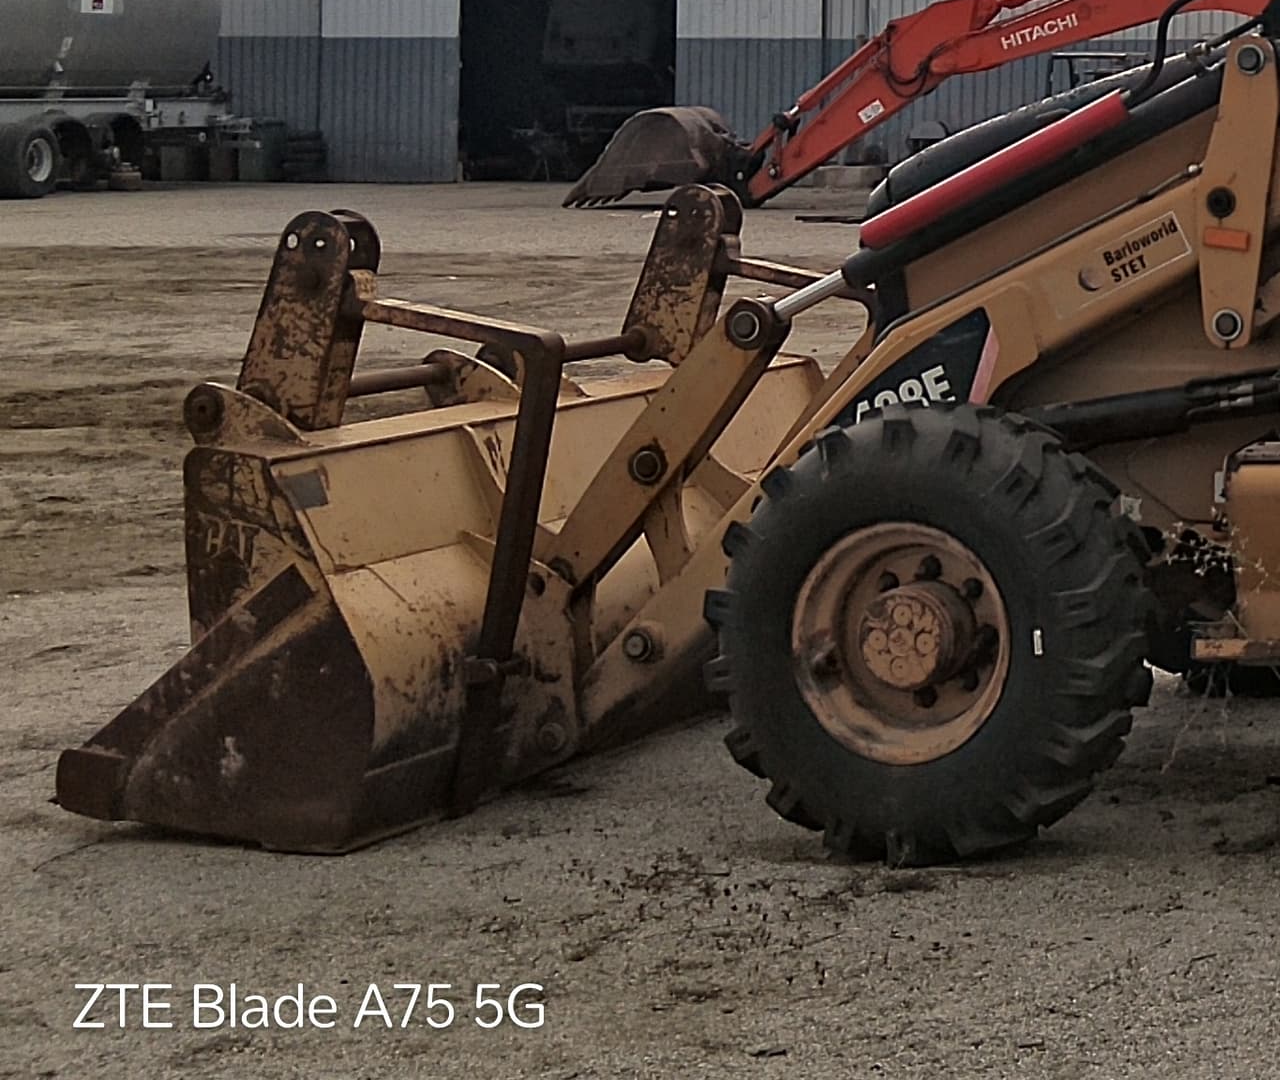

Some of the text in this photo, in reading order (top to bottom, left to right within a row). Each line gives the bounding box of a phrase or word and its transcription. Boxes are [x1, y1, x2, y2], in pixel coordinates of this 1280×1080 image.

[1000, 13, 1079, 50] HITACHI
[1103, 218, 1178, 266] Barloworld
[1111, 255, 1147, 283] STET
